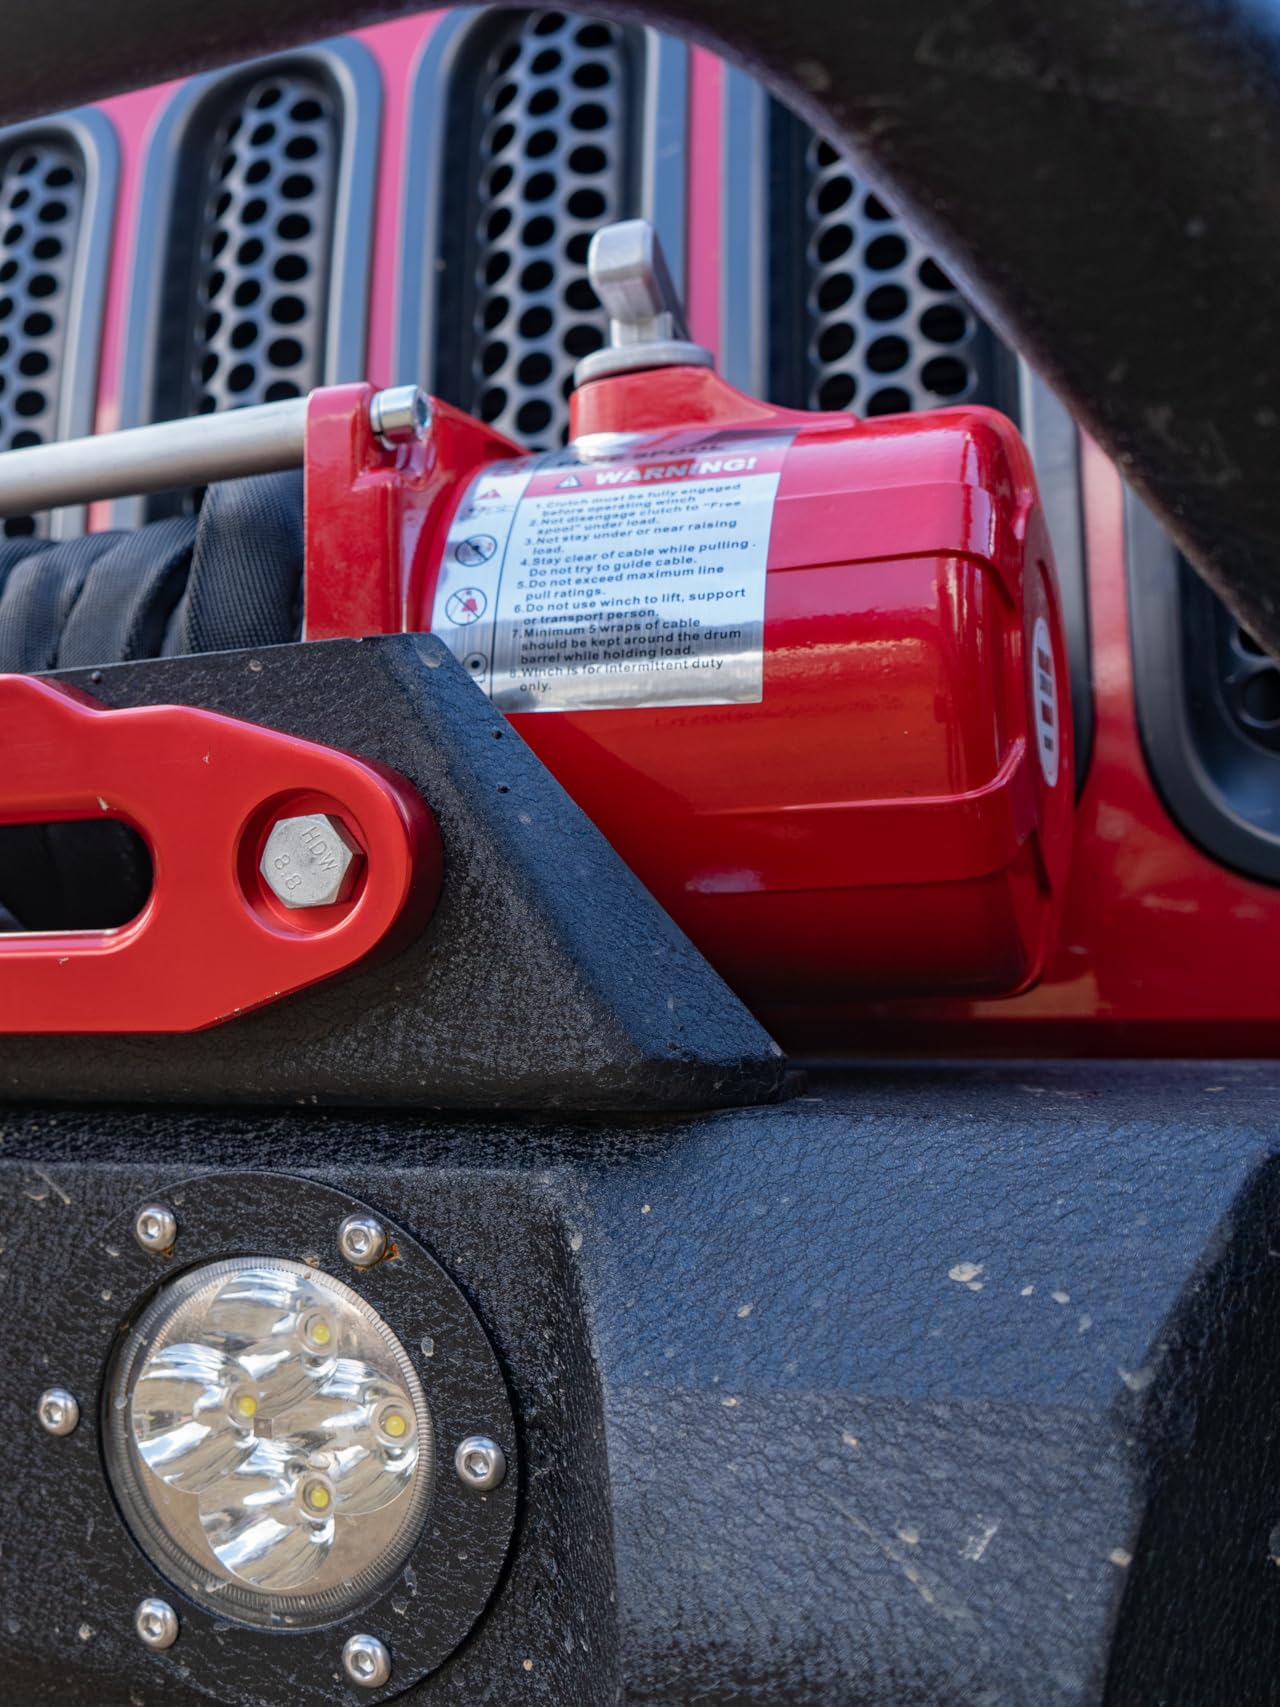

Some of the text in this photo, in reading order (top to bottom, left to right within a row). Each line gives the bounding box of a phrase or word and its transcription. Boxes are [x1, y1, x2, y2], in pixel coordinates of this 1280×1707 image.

[595, 457, 757, 485] WARNING!
[592, 494, 624, 503] must
[648, 489, 678, 498] fully
[680, 483, 741, 495] engaged
[542, 496, 695, 517] before operating winch
[567, 511, 635, 523] disengage
[640, 505, 682, 517] clutch
[686, 503, 699, 511] to
[562, 533, 590, 542] stay
[593, 529, 632, 539] under
[636, 528, 651, 536] or
[654, 525, 685, 534] near
[688, 519, 737, 531] raising
[584, 520, 621, 531] under
[626, 517, 659, 527] load.
[532, 545, 564, 555] load.
[564, 553, 598, 563] clear
[601, 550, 616, 560] of
[618, 547, 655, 558] cable
[658, 543, 695, 555] while
[529, 556, 697, 577] Do not try to guide cable.
[549, 577, 572, 587] not
[574, 573, 623, 585] exceed
[626, 567, 694, 580] maximum
[698, 565, 725, 575] line
[526, 588, 606, 601] pull ratings.
[547, 601, 569, 611] not
[572, 600, 597, 610] use
[600, 596, 640, 607] winch
[644, 595, 658, 604] to
[662, 593, 685, 604] lift,
[689, 588, 746, 602] support
[523, 609, 659, 625] or transport person.
[588, 624, 597, 634] 5
[600, 622, 641, 633] wraps
[645, 619, 659, 631] of
[662, 618, 701, 629] cable
[521, 629, 741, 651] should be kept around the drum
[520, 645, 695, 664] barrel while holding load.
[567, 666, 578, 675] is
[582, 664, 601, 674] for
[605, 659, 688, 673] intermittent
[691, 659, 724, 670] duty
[520, 681, 552, 693] only.
[301, 826, 339, 872] HDW
[274, 854, 302, 890] 8.8
